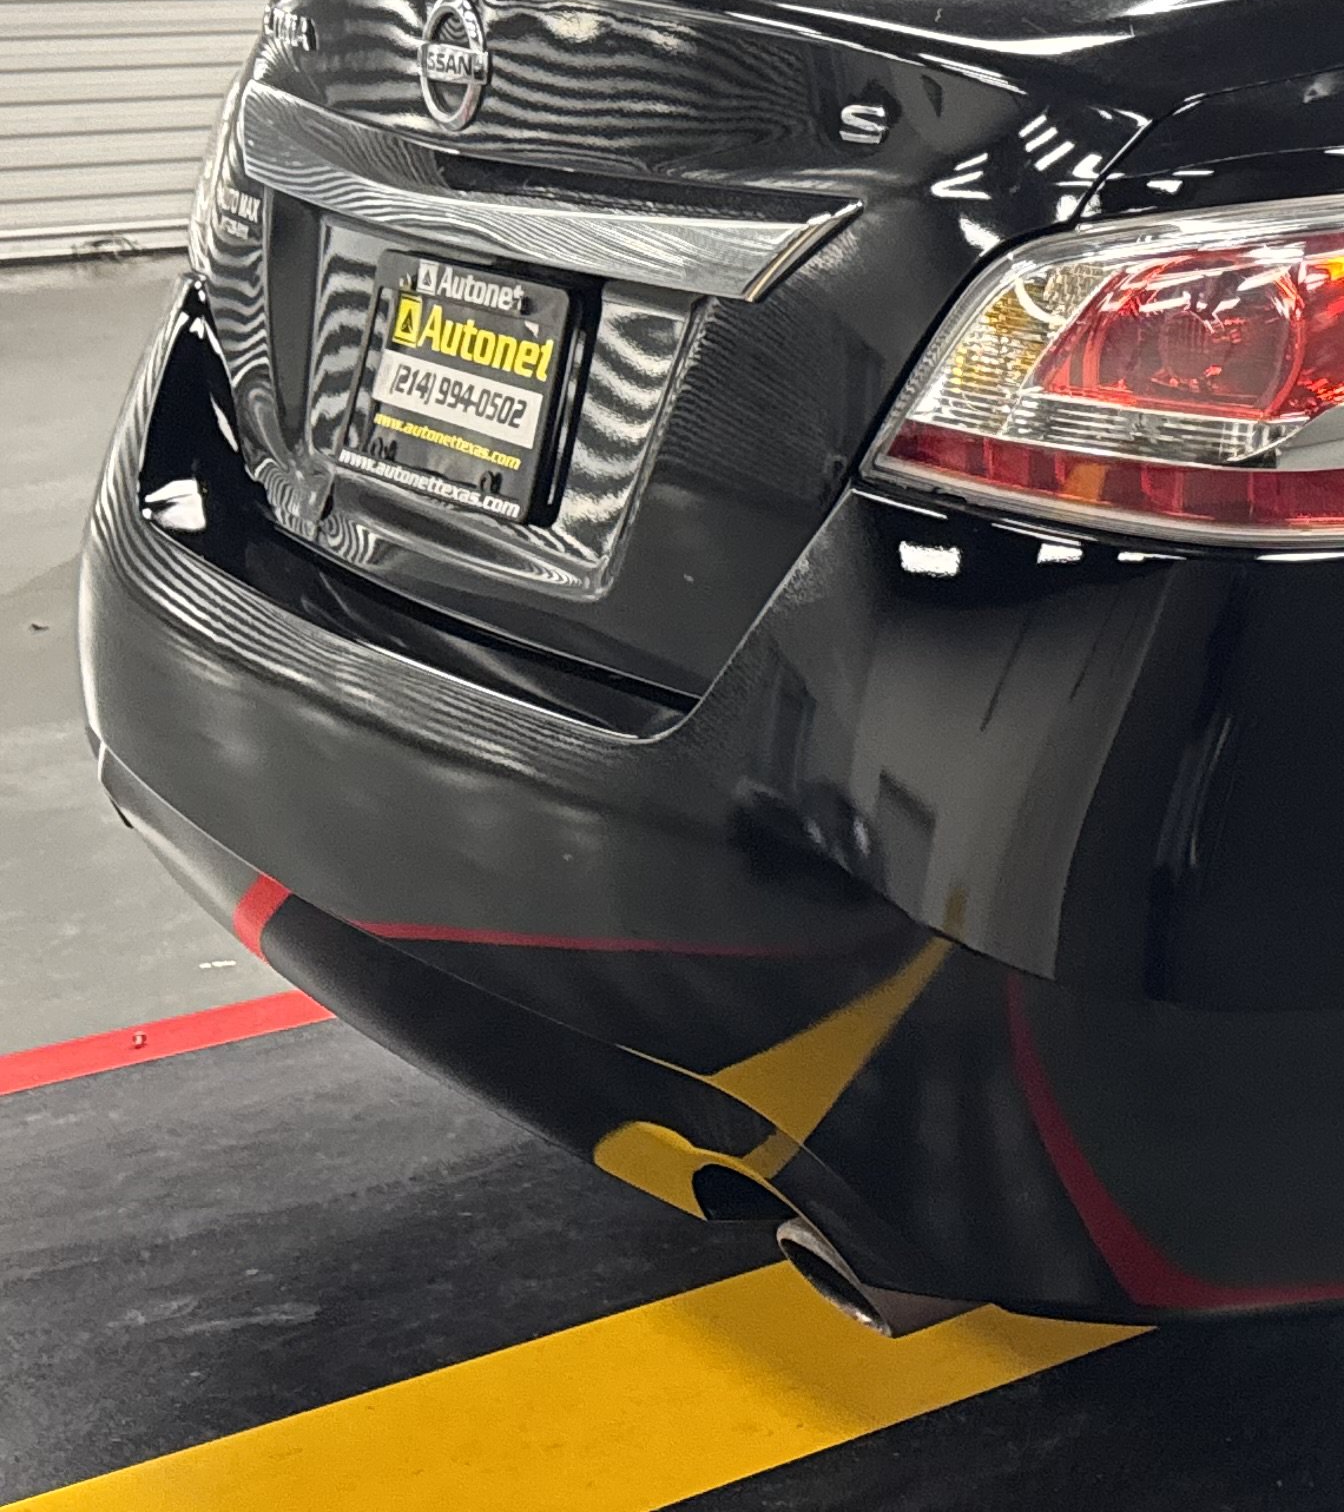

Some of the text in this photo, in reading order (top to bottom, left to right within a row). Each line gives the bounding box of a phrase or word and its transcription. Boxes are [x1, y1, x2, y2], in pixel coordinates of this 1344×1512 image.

[427, 50, 475, 77] SSAN
[839, 104, 887, 144] S
[437, 266, 525, 311] Autonet
[417, 304, 554, 382] Autonet
[389, 364, 527, 429] (214) 994-0502
